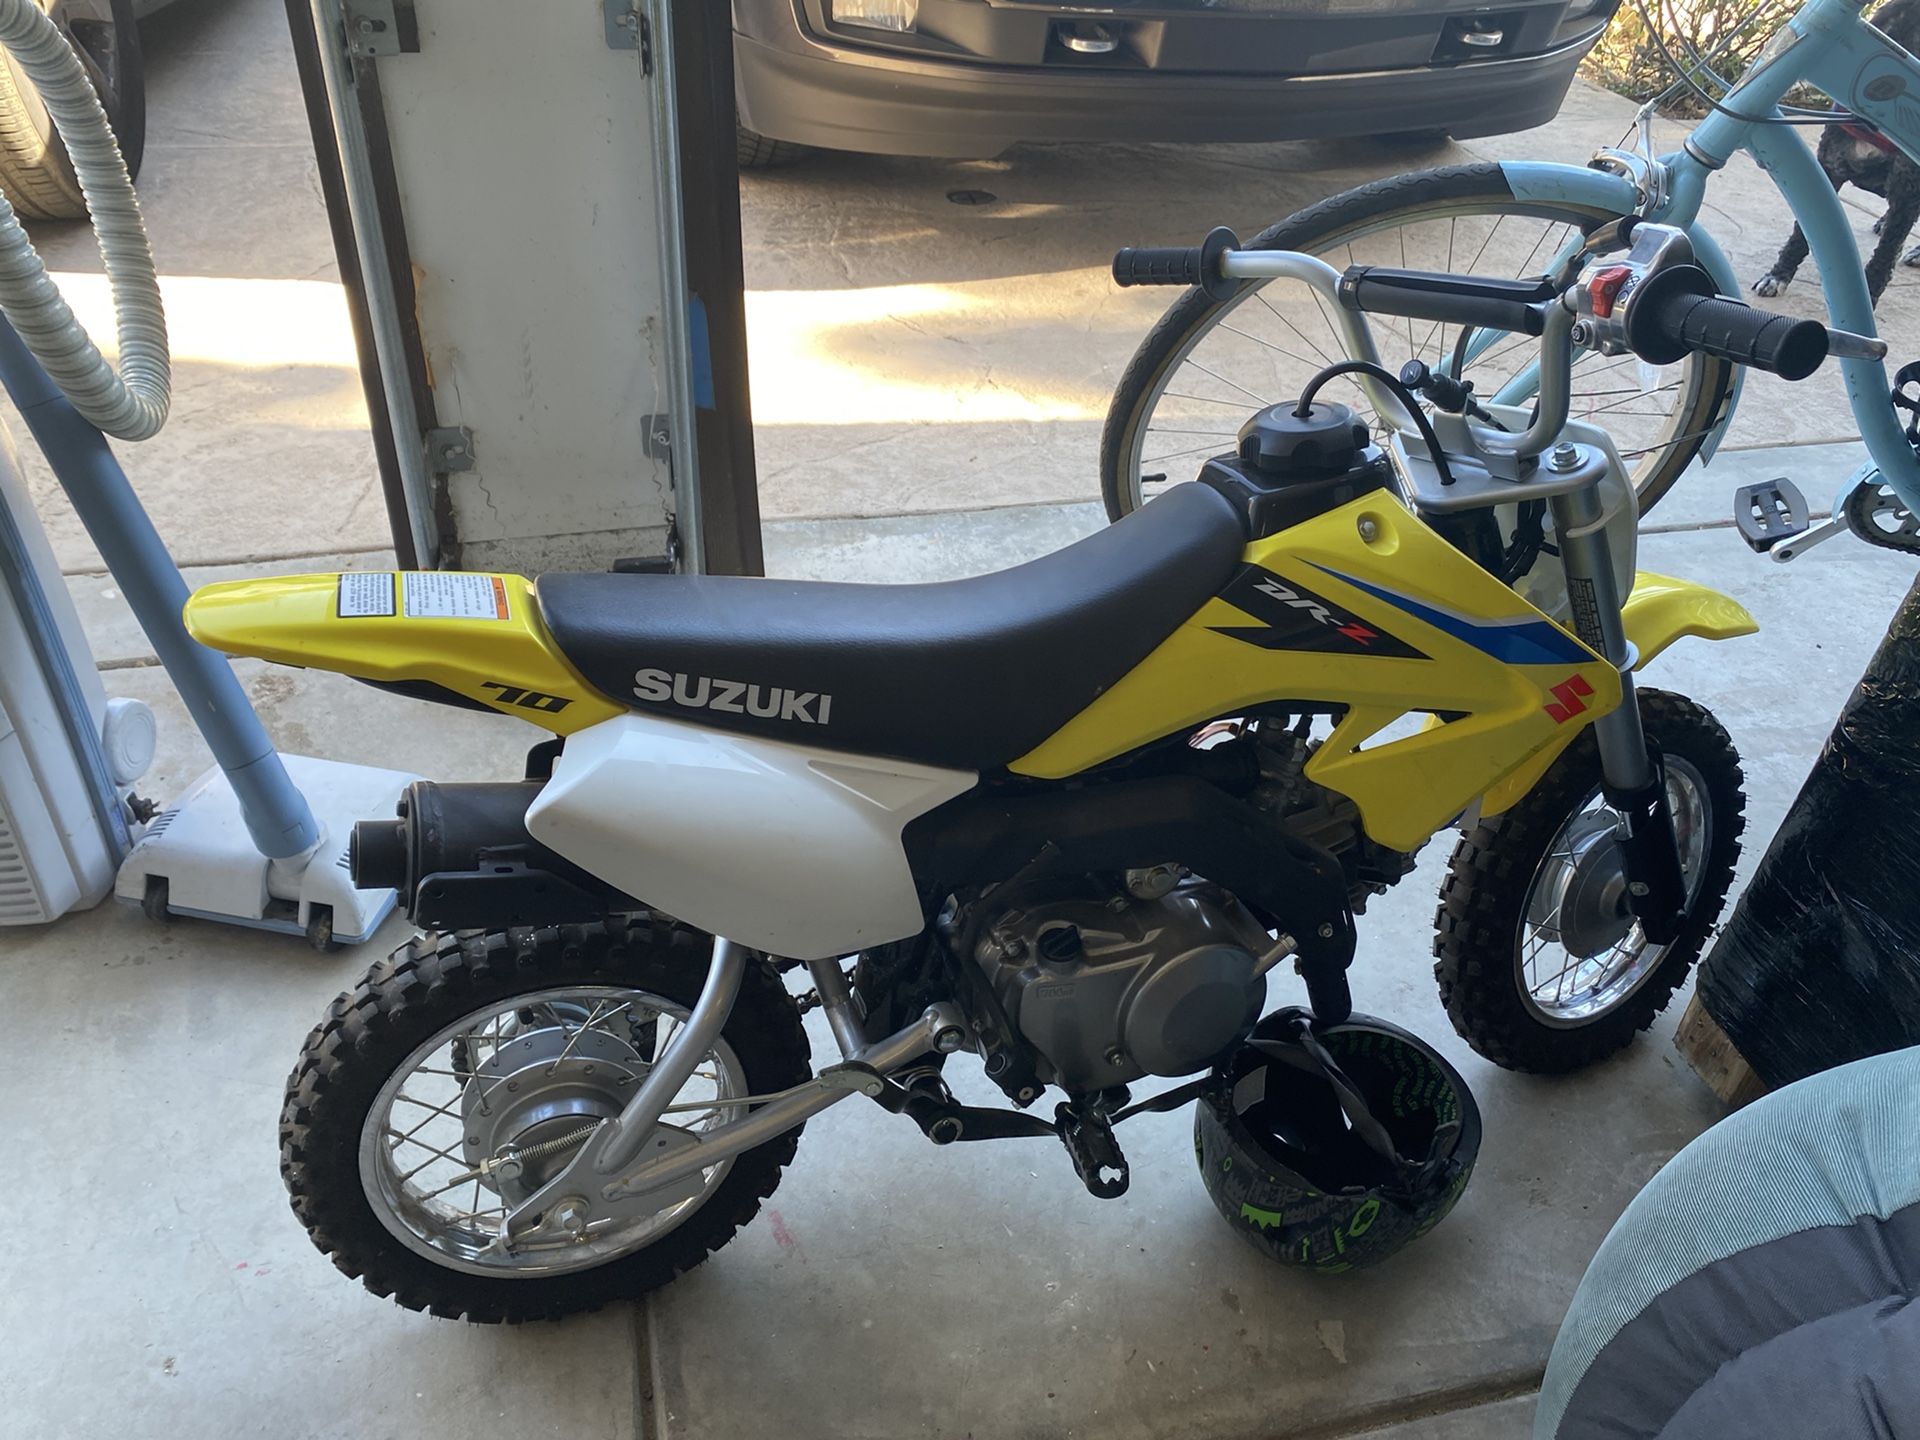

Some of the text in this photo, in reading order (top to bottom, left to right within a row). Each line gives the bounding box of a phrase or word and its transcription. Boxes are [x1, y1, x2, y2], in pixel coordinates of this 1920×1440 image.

[1252, 577, 1379, 646] DR-Z
[481, 682, 575, 713] 70
[633, 668, 832, 724] SUZUKI
